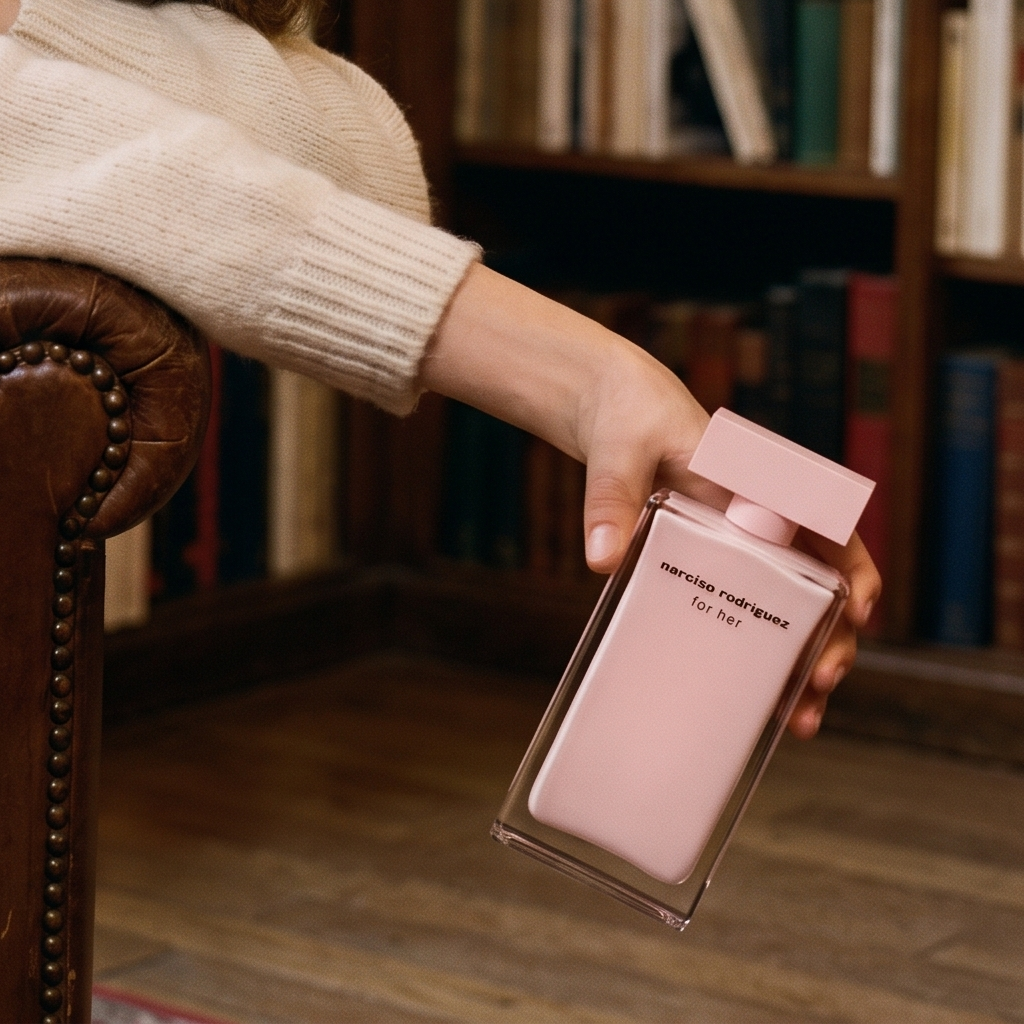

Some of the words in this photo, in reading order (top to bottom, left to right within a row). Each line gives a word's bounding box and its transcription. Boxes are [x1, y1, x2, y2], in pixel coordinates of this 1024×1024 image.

[660, 561, 716, 593] narciso
[719, 590, 790, 630] rodriguez
[691, 596, 713, 614] for
[716, 609, 743, 628] her
